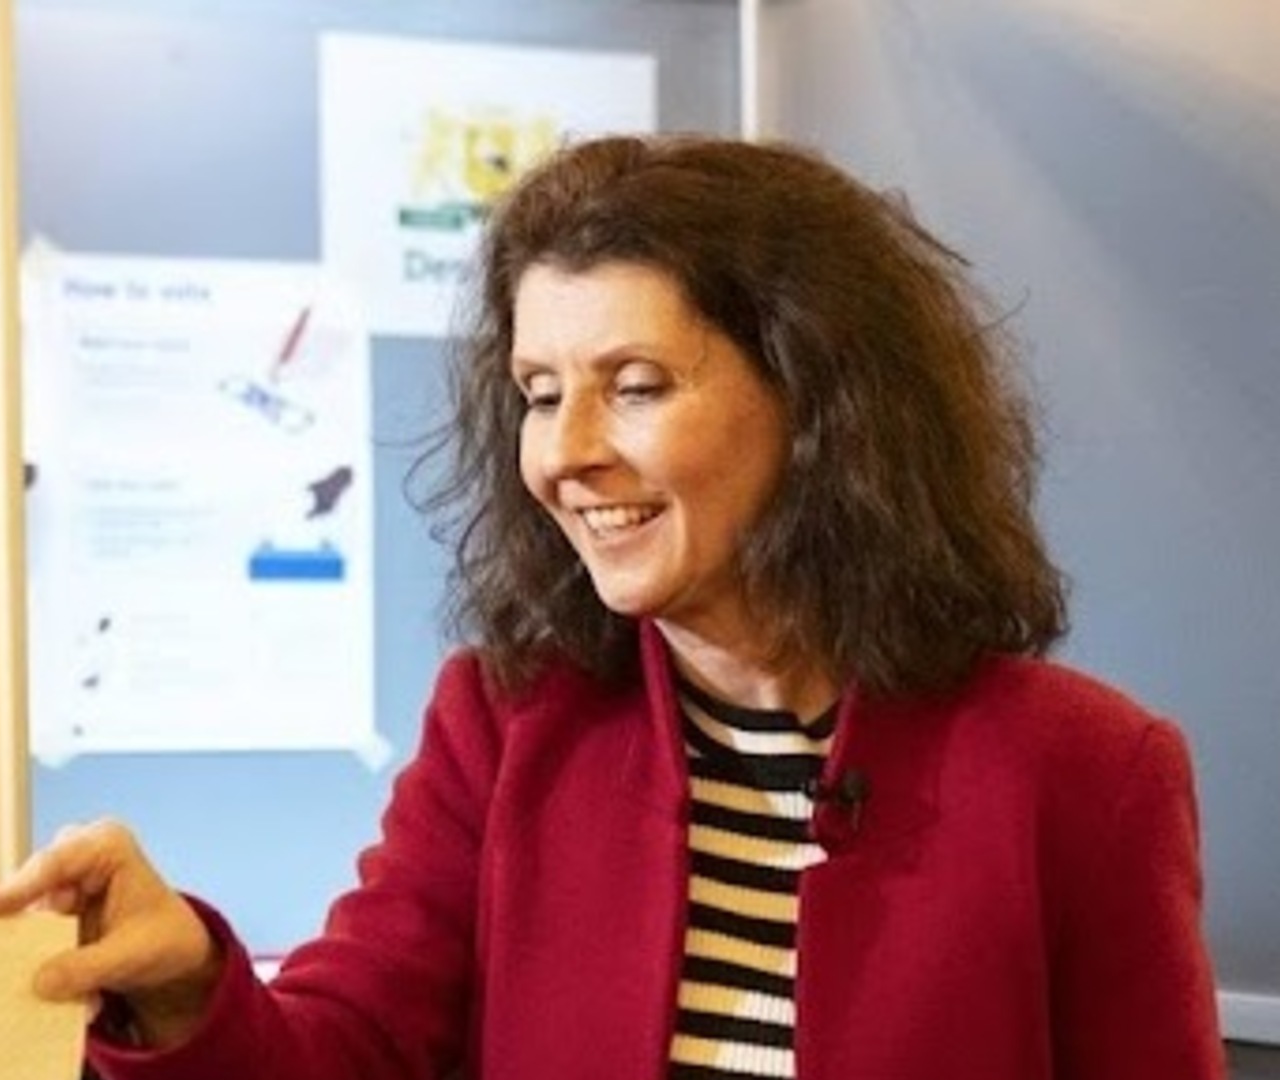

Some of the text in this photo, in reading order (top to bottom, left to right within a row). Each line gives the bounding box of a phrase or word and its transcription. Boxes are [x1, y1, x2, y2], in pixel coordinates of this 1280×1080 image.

[64, 278, 211, 301] How to vote
